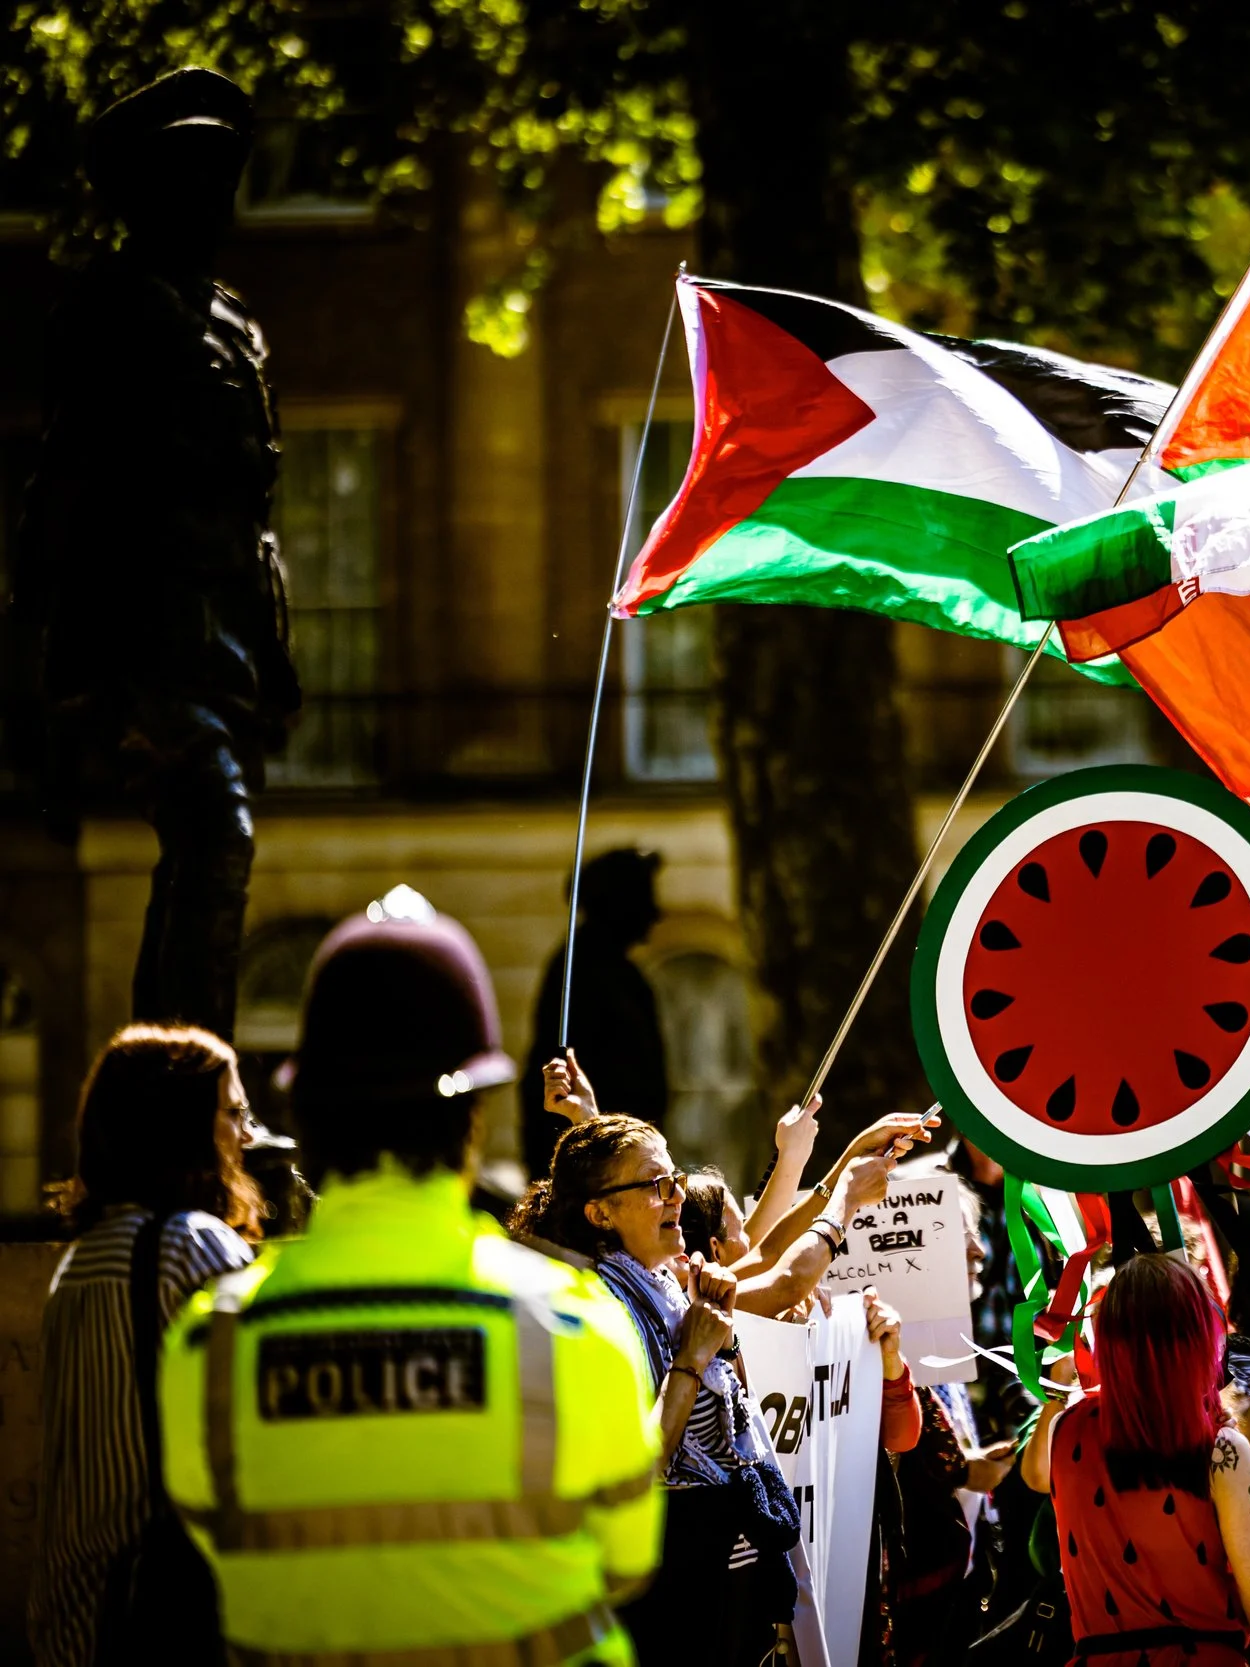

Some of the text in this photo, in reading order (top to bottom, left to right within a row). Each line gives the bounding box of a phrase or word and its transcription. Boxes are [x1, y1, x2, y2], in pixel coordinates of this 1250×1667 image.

[893, 1211, 908, 1226] A
[869, 1229, 924, 1252] BEEN
[821, 1262, 892, 1283] ALCOLM
[265, 1355, 475, 1413] POLICE
